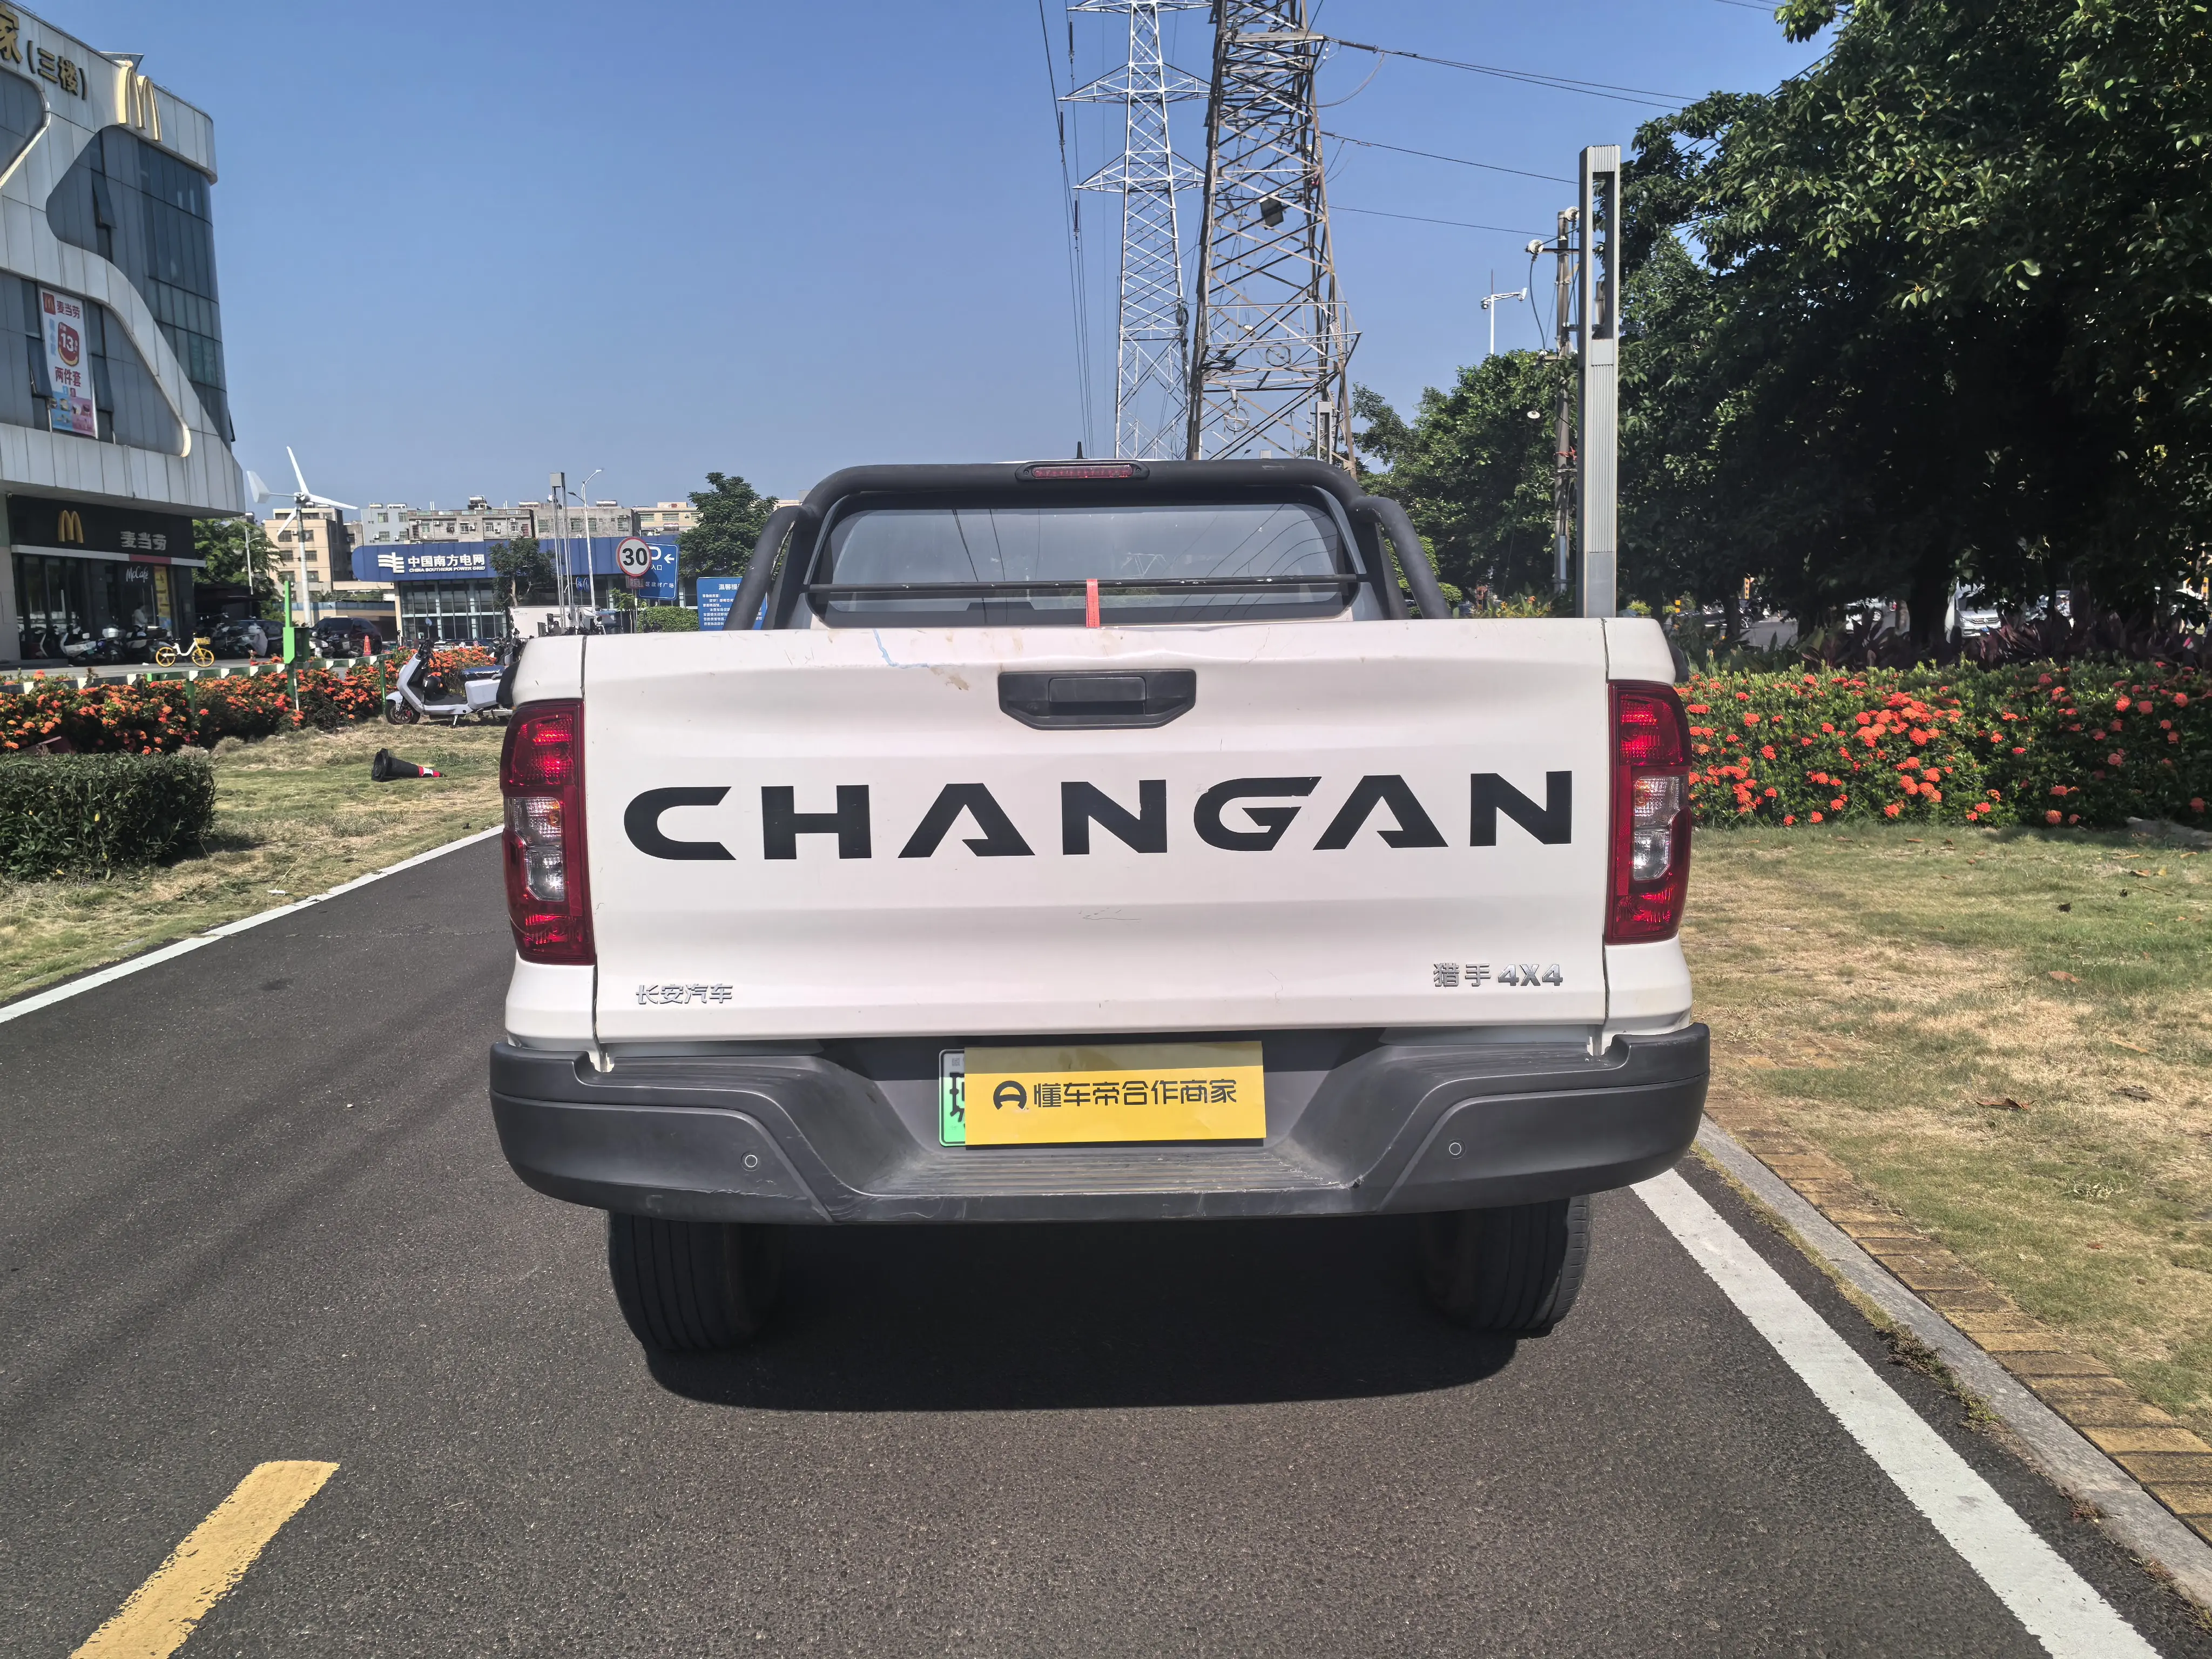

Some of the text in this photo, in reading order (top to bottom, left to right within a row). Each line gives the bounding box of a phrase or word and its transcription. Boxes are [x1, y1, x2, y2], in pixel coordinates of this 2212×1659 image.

[57, 300, 80, 319] 麦当劳
[55, 366, 81, 387] 两件套
[120, 531, 167, 551] 麦当劳
[408, 554, 485, 568] 中国南方电网
[622, 548, 648, 566] 30
[623, 771, 1573, 860] CHANGAN
[1433, 962, 1563, 987] 猎手 4X4
[636, 983, 733, 1004] 长安汽车
[1034, 1079, 1237, 1108] 懂车帝合作商家
